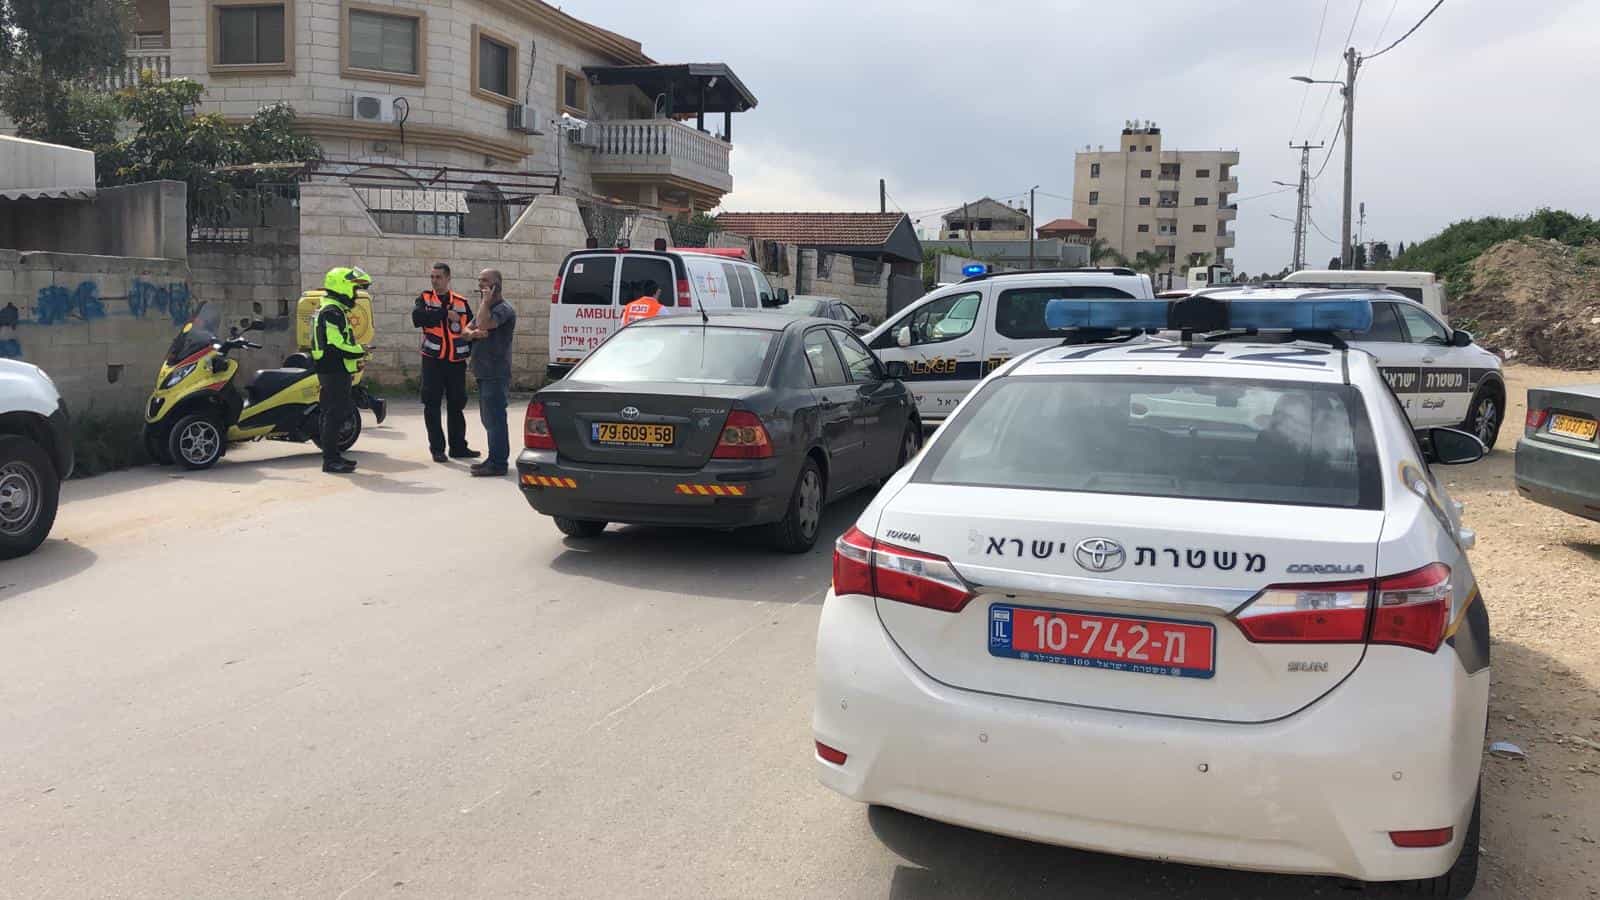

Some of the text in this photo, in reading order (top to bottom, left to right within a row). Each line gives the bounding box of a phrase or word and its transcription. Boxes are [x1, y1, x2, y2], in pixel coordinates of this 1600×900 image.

[562, 325, 579, 334] אדום
[1425, 372, 1463, 388] משטרת
[1133, 545, 1267, 573] משטרת
[1286, 563, 1365, 574] COROLLA
[995, 621, 1008, 638] IL
[1072, 658, 1090, 666] 100
[1288, 661, 1329, 673] SUN
[1133, 664, 1167, 675] משטרת
